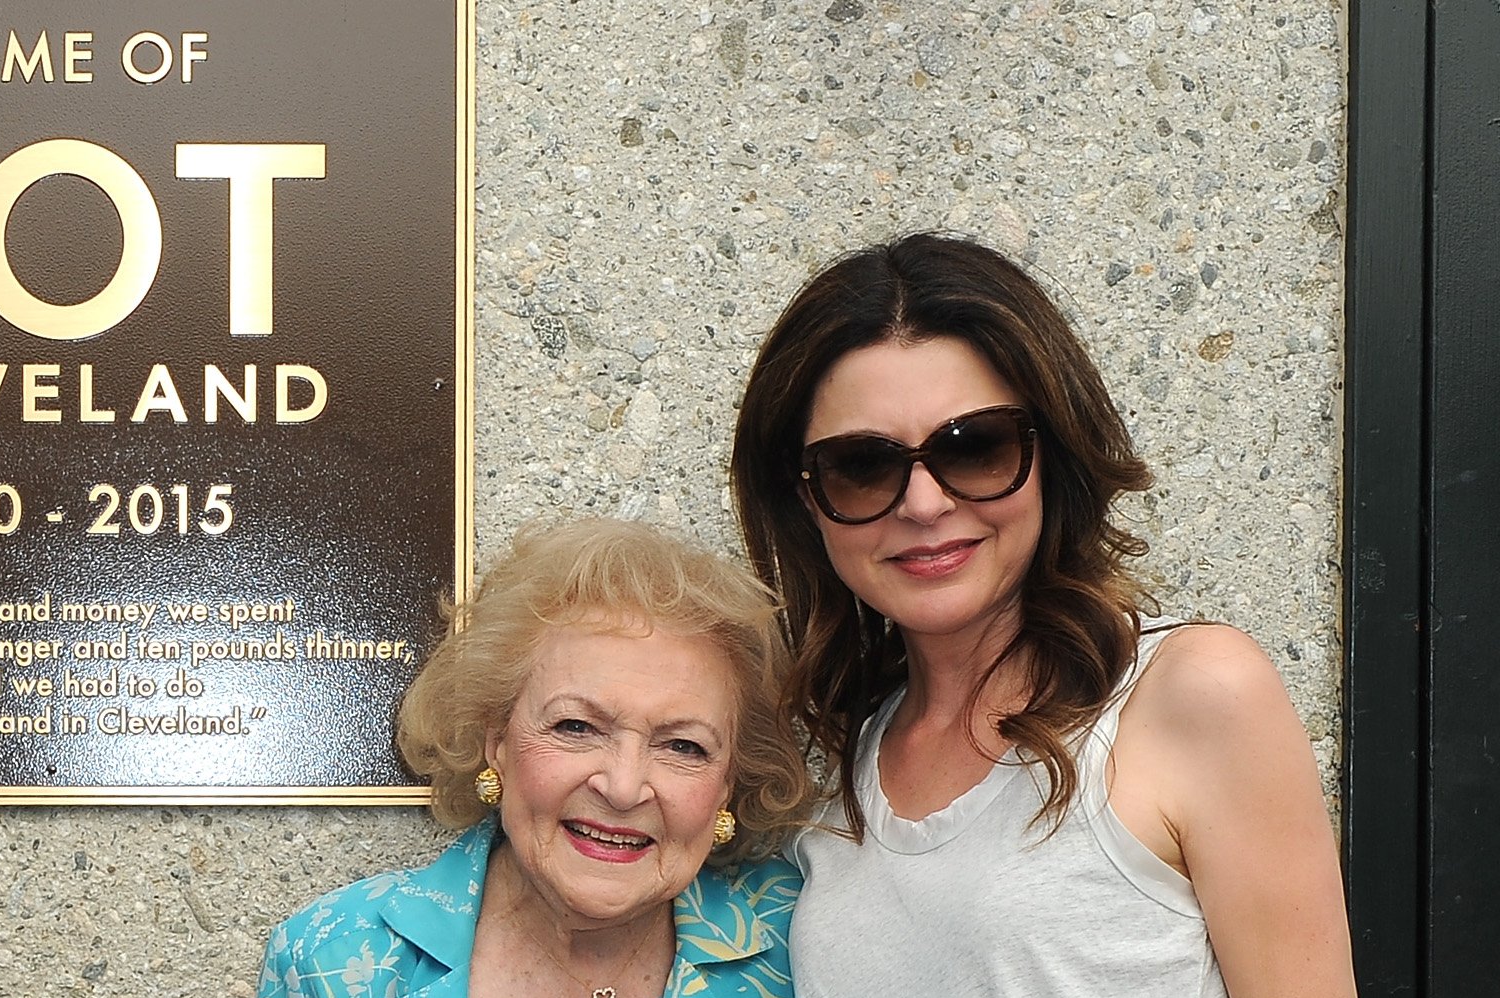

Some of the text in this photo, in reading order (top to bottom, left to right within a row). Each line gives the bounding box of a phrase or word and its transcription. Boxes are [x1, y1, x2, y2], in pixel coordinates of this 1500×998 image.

[121, 31, 210, 84] OF
[45, 510, 64, 523] -
[86, 483, 235, 535] 2015
[62, 603, 157, 630] money
[167, 603, 208, 622] we
[219, 599, 295, 630] spent
[74, 631, 128, 659] and
[138, 636, 181, 659] ten
[191, 631, 296, 667] pounds
[305, 630, 414, 664] thinner,
[11, 678, 54, 697] we
[64, 668, 119, 697] had
[127, 674, 156, 697] to
[166, 668, 204, 697] do
[62, 709, 88, 734] in
